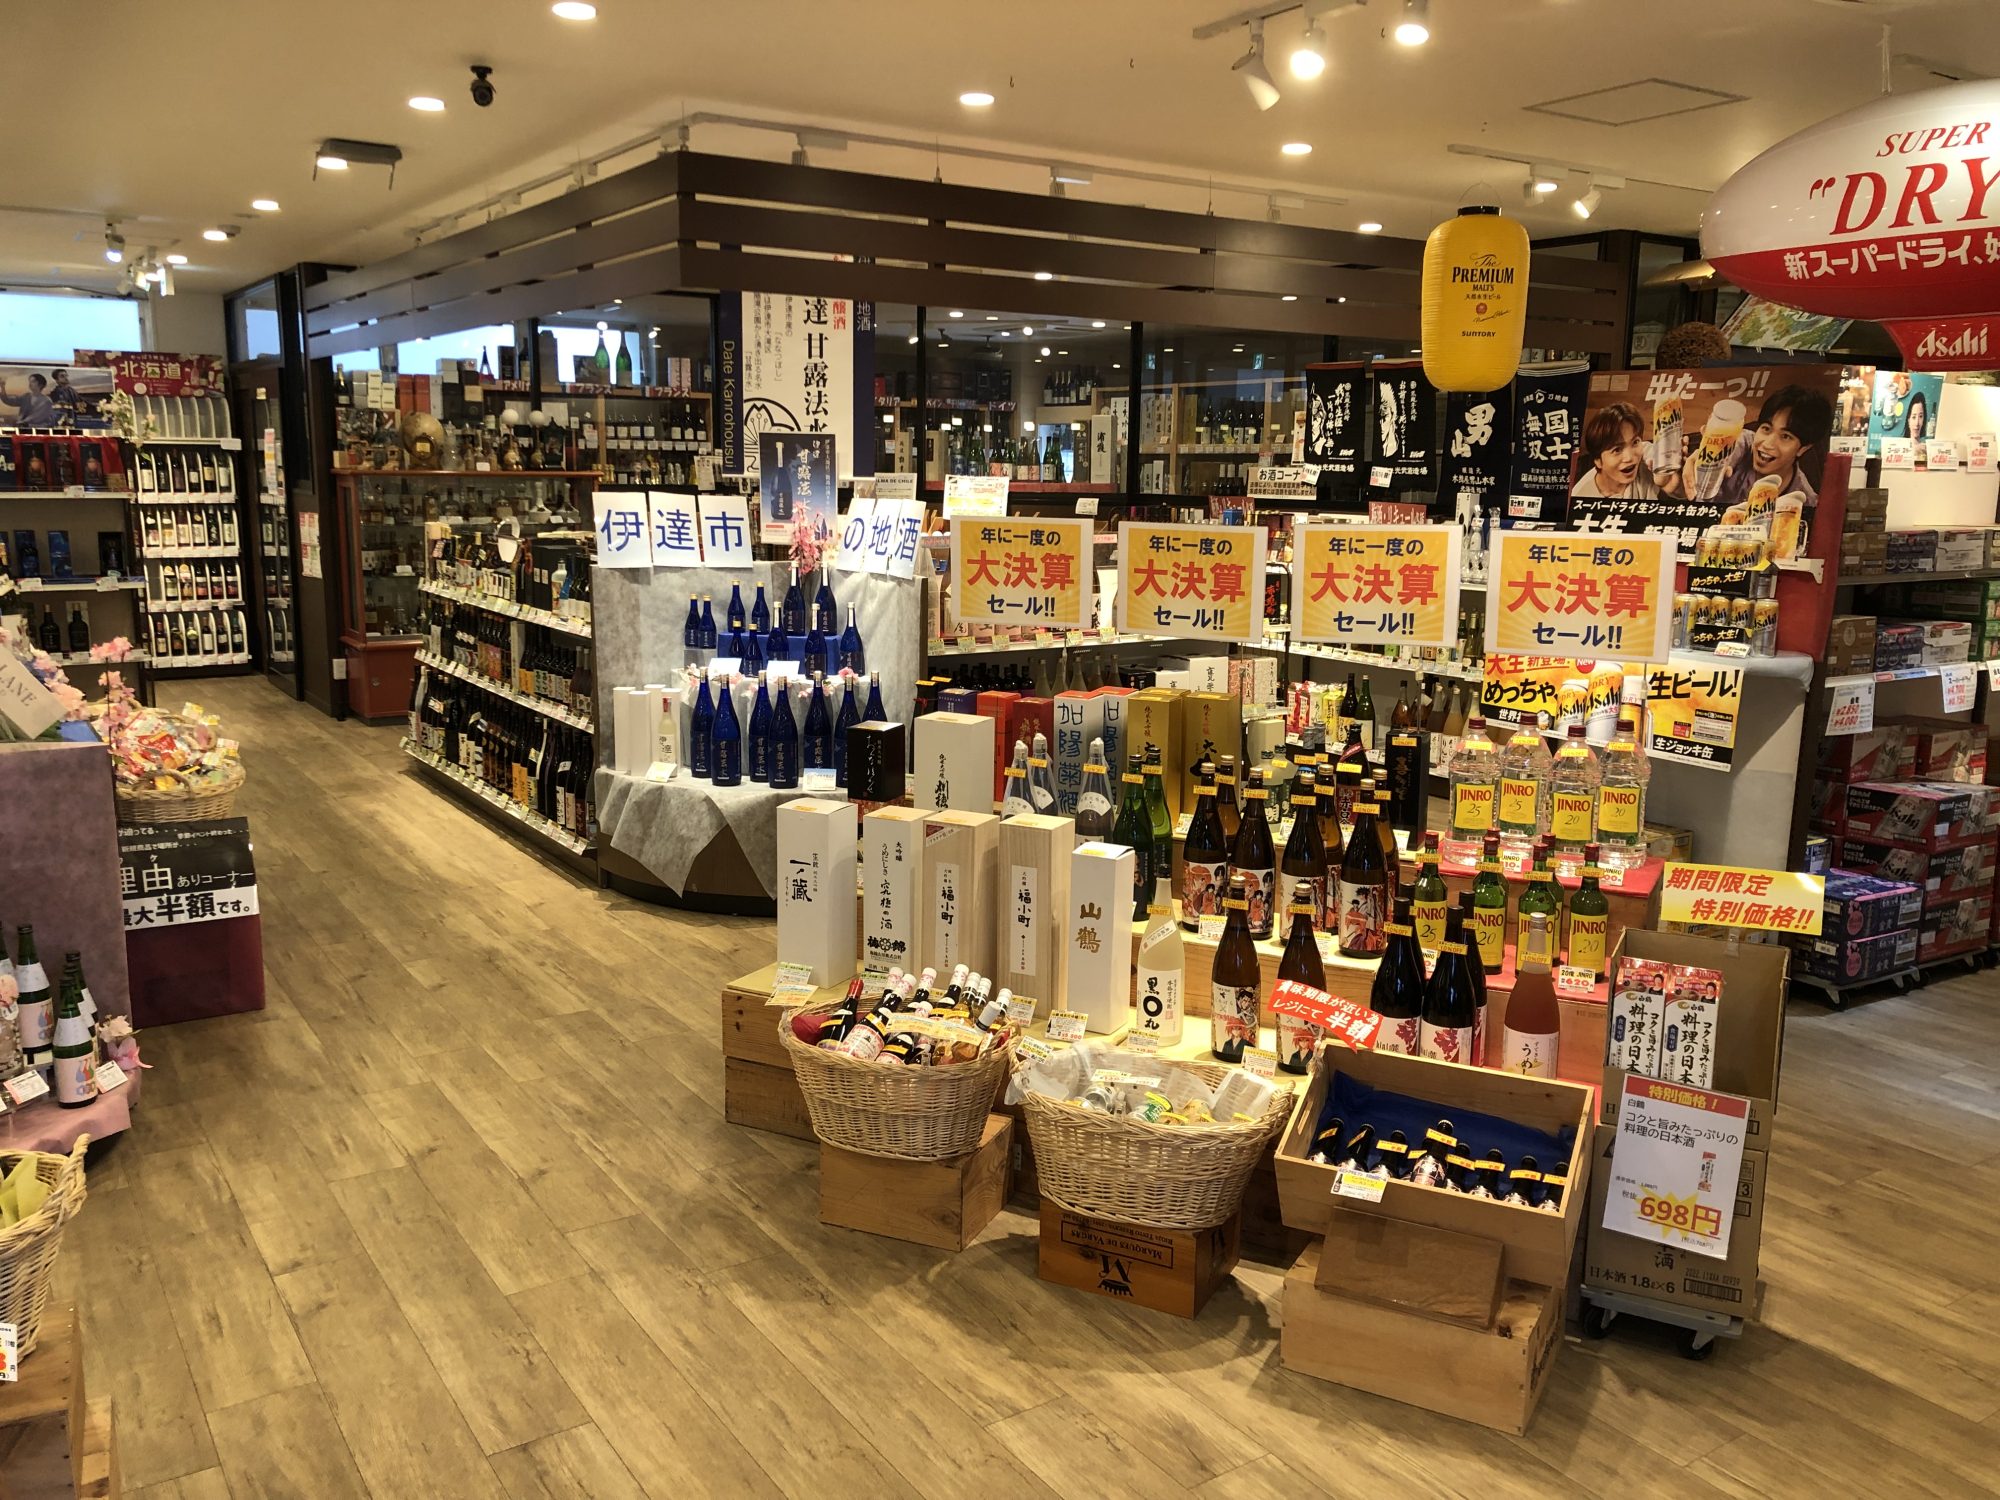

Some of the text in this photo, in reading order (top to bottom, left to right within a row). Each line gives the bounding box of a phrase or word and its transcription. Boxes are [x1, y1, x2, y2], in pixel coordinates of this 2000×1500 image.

[1876, 122, 1990, 157] SUPER
[1452, 266, 1514, 284] PREMIUM
[856, 302, 871, 332] 地酒
[1917, 326, 1988, 358] Asahi
[120, 361, 181, 379] 北海道
[575, 382, 613, 395] フランス
[655, 386, 691, 398] フランス
[722, 340, 737, 468] Date Kanrohousui
[875, 396, 900, 407] タリア
[989, 401, 1017, 411] ドイツ
[1451, 403, 1496, 458] 男山
[1525, 409, 1549, 460] 無双
[1544, 409, 1572, 460] 国士
[600, 508, 921, 562] 伊達市 の地酒
[981, 526, 1061, 547] 年に一度の
[1149, 535, 1232, 556] 年に一度の
[1328, 536, 1424, 556] 年に一度の
[1528, 544, 1634, 567] 年に一度の
[966, 550, 1075, 591] 大決算
[1133, 558, 1246, 603] 大決算
[1310, 562, 1440, 606] 大決算
[1506, 571, 1651, 618] 大決算
[1576, 657, 1594, 666] New
[1648, 669, 1740, 700] 生ビール!
[1653, 737, 1714, 760] 生ジョッキ缶
[1459, 788, 1492, 802] JINRO
[1503, 782, 1535, 797] JINRO
[1603, 791, 1637, 805] JINRO
[1467, 803, 1482, 817] 25
[1508, 799, 1522, 811] 25
[1557, 798, 1590, 812] JINRO
[1610, 806, 1627, 818] 20
[1564, 814, 1580, 825] 20
[177, 871, 254, 888] ありコーナー
[1666, 867, 1774, 897] 期間限定
[941, 886, 955, 926] 福小町
[1017, 888, 1032, 928] 福小町
[1690, 898, 1815, 931] 特別価格!!
[1419, 925, 1437, 943] 25
[1520, 918, 1553, 935] JIO
[1573, 919, 1606, 935] JINRO
[1477, 931, 1497, 946] 20
[1578, 939, 1600, 954] 20
[1273, 998, 1375, 1043] レジにて 半額
[1625, 1003, 1648, 1074] 料理の日本
[1678, 1012, 1701, 1084] 料理の日本
[1521, 1043, 1533, 1074] うめ
[1627, 1098, 1645, 1108] 白鶴
[1648, 1085, 1719, 1110] 特別価格!
[1624, 1125, 1696, 1148] 料理の日本酒
[1625, 1111, 1739, 1146] コクと旨みたっぷりの
[1640, 1197, 1722, 1236] 698円
[1589, 1266, 1627, 1284] 日本酒
